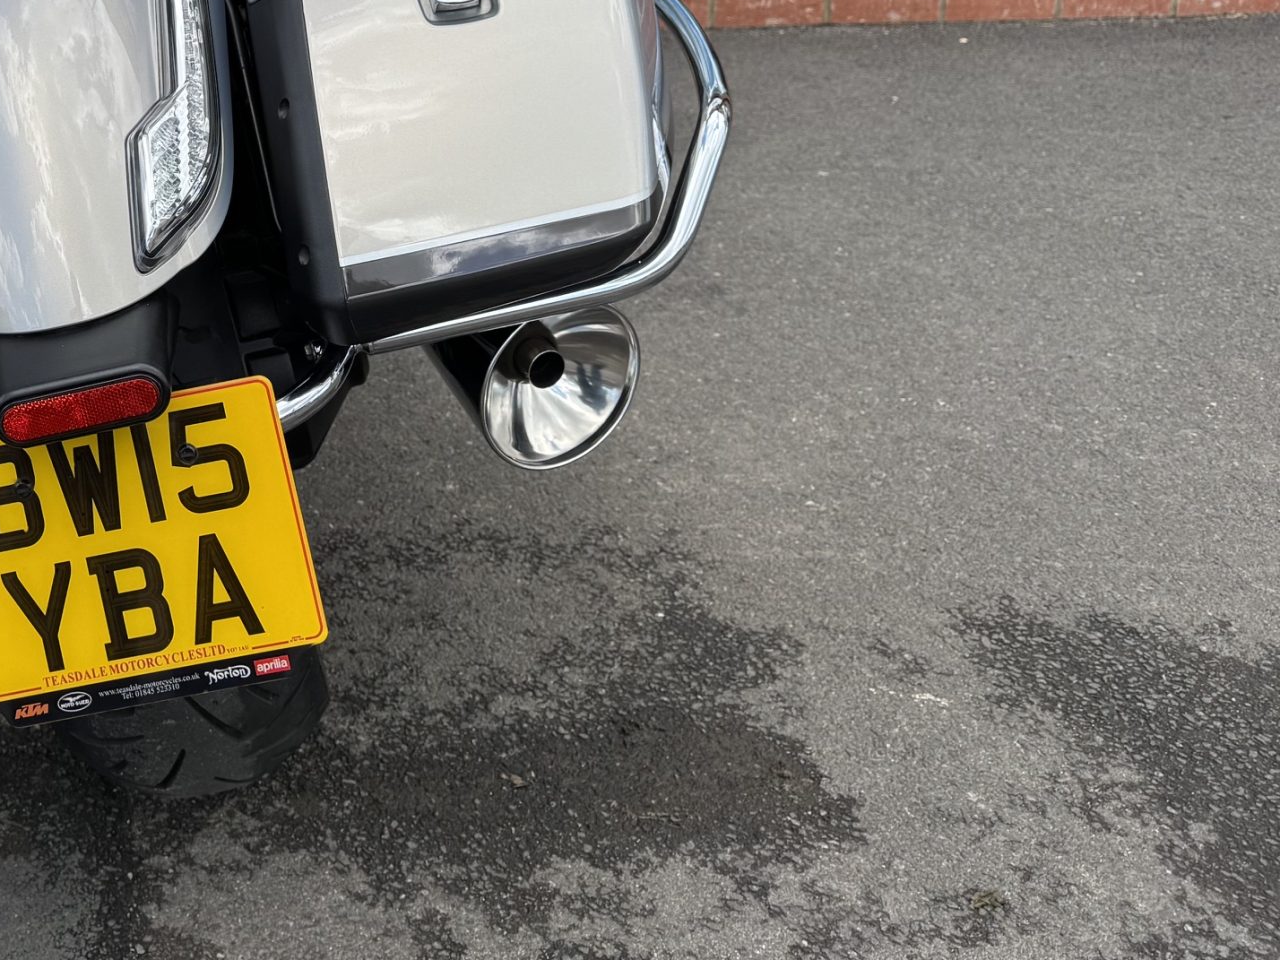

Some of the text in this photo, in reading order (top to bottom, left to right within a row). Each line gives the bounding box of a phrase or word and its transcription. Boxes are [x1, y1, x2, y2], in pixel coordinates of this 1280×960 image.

[0, 532, 266, 673] YBA
[42, 663, 108, 688] TEASDALE
[204, 665, 251, 685] Norton
[256, 658, 288, 675] aprilia
[98, 673, 201, 697] www.teasdale-motorcycles.co.uk
[122, 689, 134, 700] Tel:
[135, 687, 155, 698] 01845
[15, 703, 49, 720] KTM
